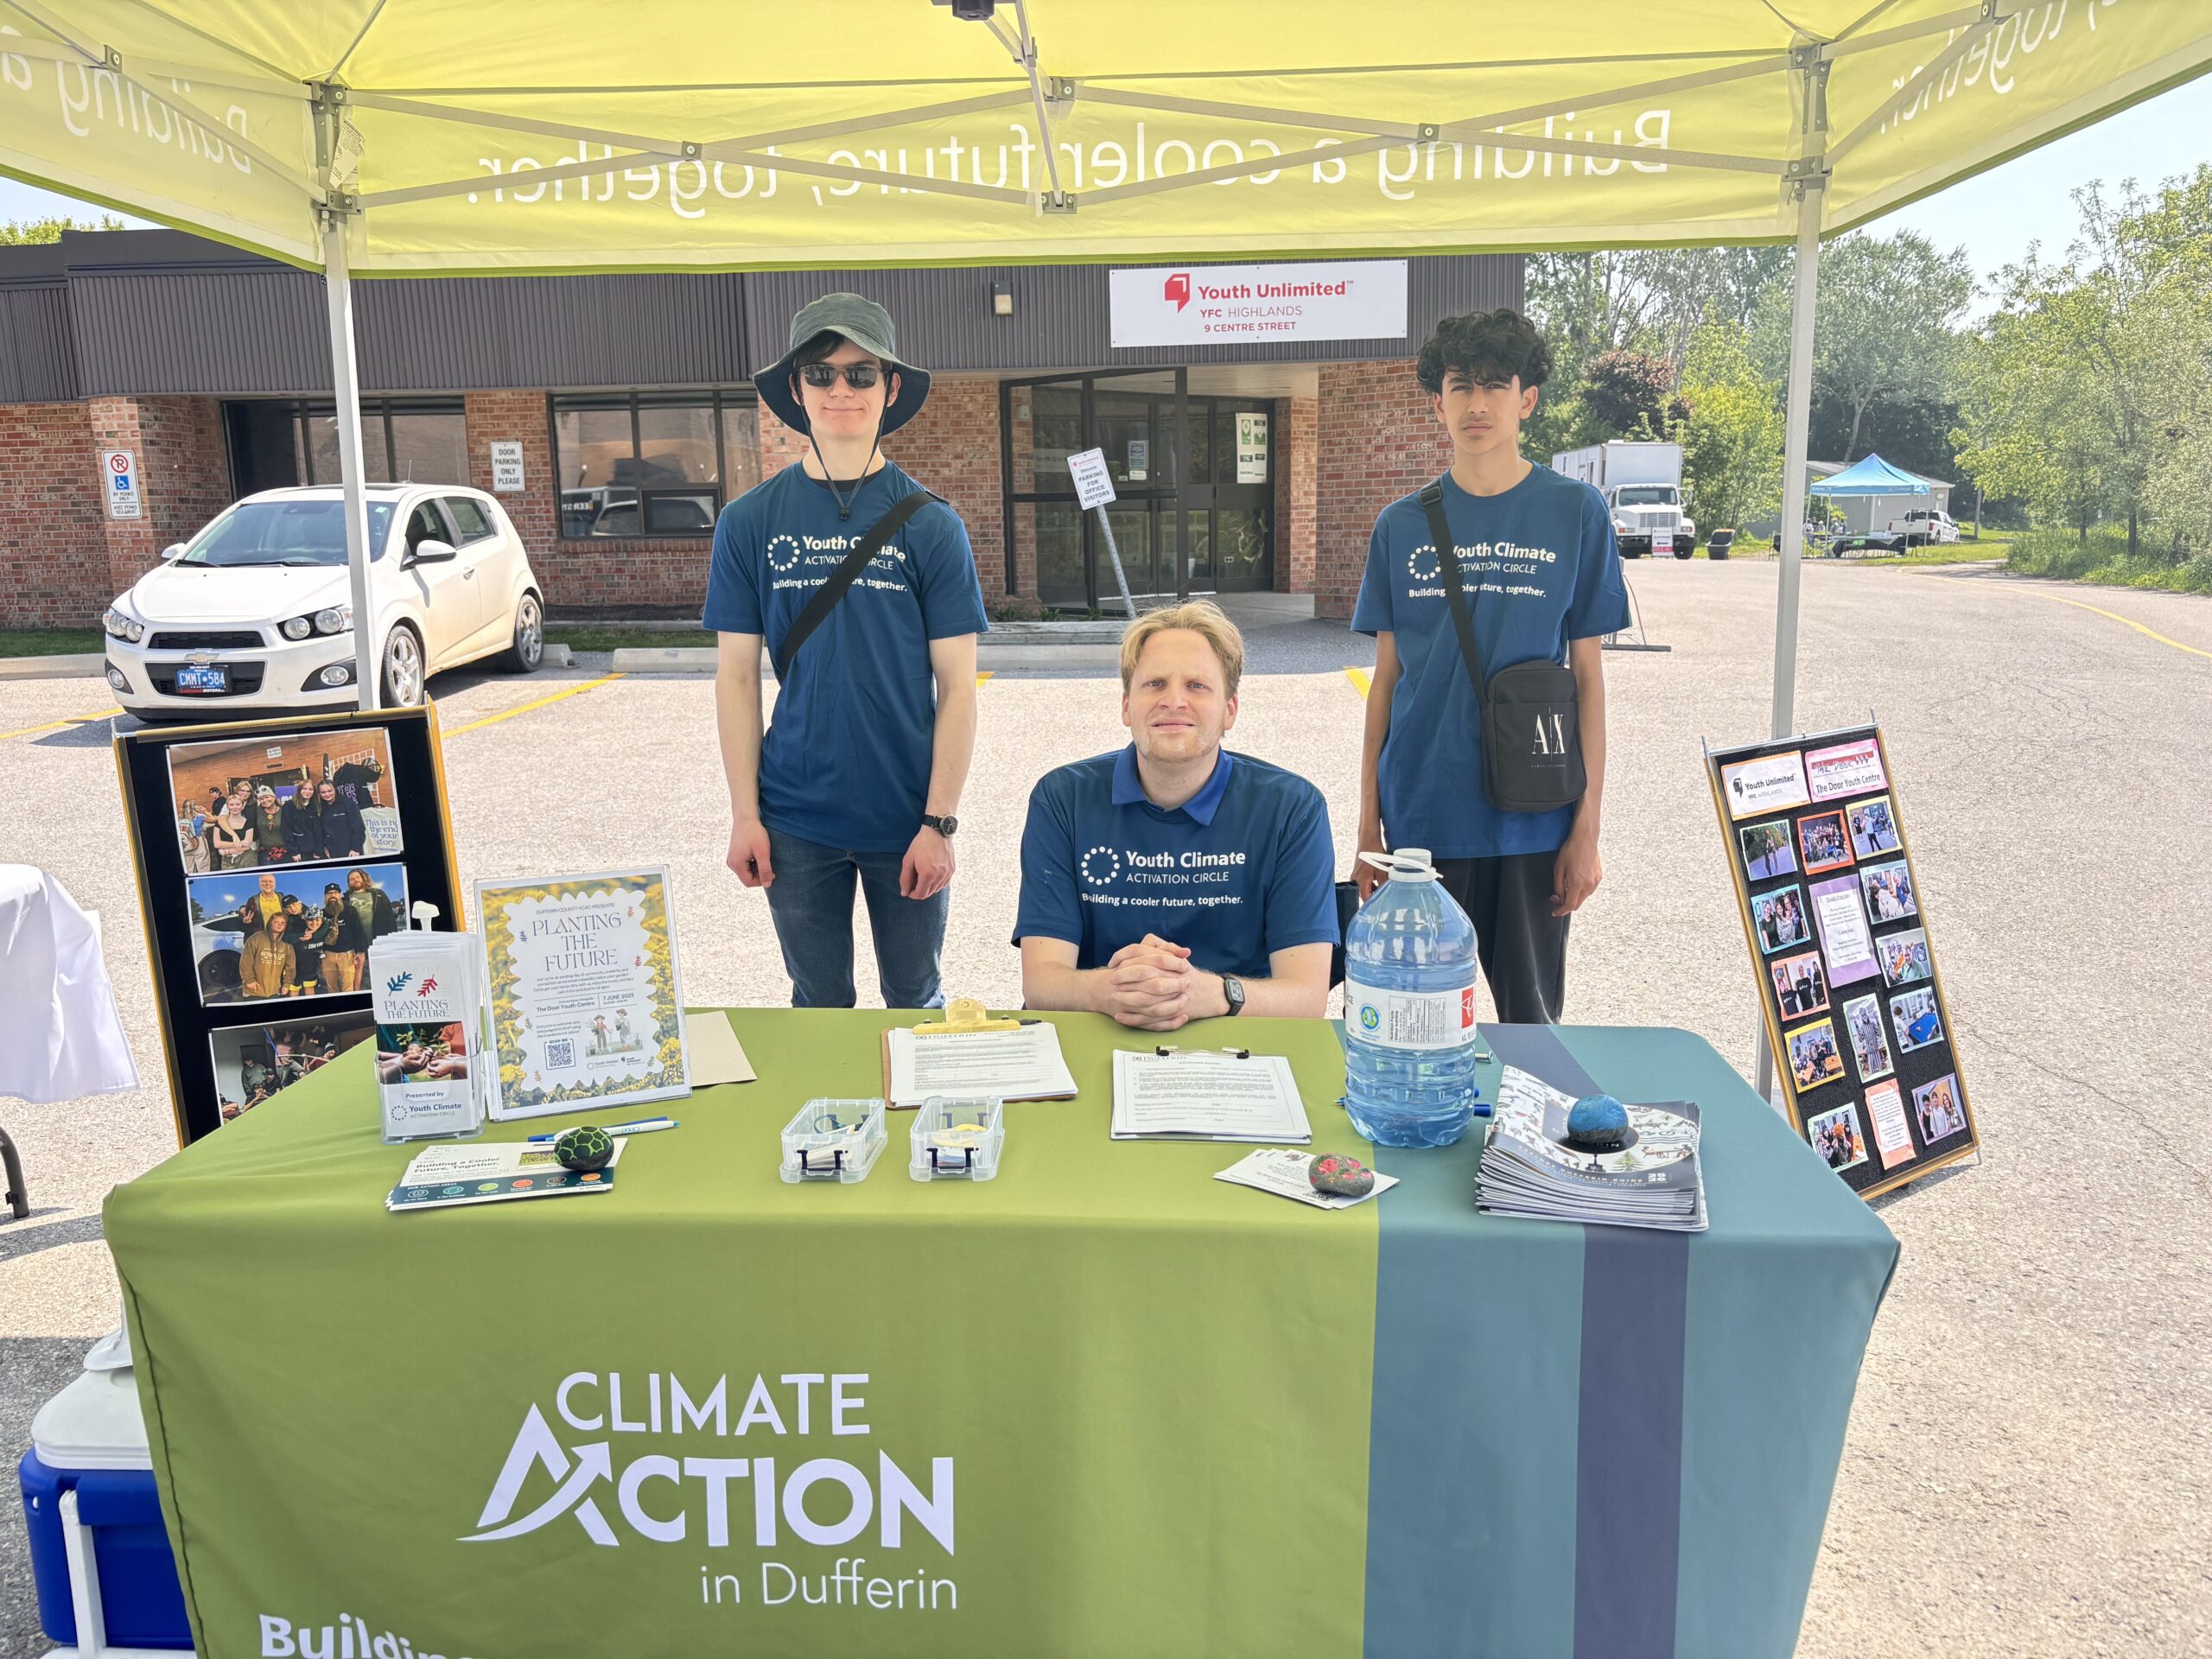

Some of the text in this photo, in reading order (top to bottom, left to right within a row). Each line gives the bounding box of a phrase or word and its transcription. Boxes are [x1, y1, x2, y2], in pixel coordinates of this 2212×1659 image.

[1198, 284, 1250, 300] Youth
[1200, 306, 1302, 318] YFC HIGHLANDS
[1214, 323, 1255, 333] CENTRE
[1258, 321, 1296, 332] STREET
[1078, 470, 1103, 482] PARKING
[1084, 485, 1106, 494] OFFICE
[1084, 491, 1109, 502] VISITORS
[803, 536, 848, 550] Youth
[1494, 542, 1556, 563] Climate
[1458, 562, 1537, 575] CTIVATION CIRCLE
[773, 579, 802, 589] Building
[868, 578, 907, 592] together.
[1408, 588, 1446, 598] Building
[1506, 587, 1546, 597] together.
[180, 671, 226, 686] CMMT 584
[1745, 782, 1765, 791] Youth
[1815, 773, 1881, 794] The Door Youth Centre
[383, 824, 398, 833] end
[1126, 850, 1246, 868] Youth Climate
[1126, 871, 1230, 884] ACTIVATION CIRCLE
[1082, 893, 1120, 906] Building
[1130, 897, 1160, 906] cooler
[1162, 897, 1196, 906] future,
[1198, 894, 1243, 906] together.
[532, 912, 621, 937] PLANTING
[561, 933, 598, 951] THE
[545, 949, 618, 972] FUTURE
[385, 1000, 448, 1010] PLANTING
[387, 1008, 449, 1019] THE FUTURE
[433, 1103, 461, 1111] Climate
[453, 1161, 500, 1170] Together.
[556, 1370, 870, 1436] CLIMATE
[455, 1402, 955, 1556] ACTION
[701, 1557, 957, 1609] in Dufferin
